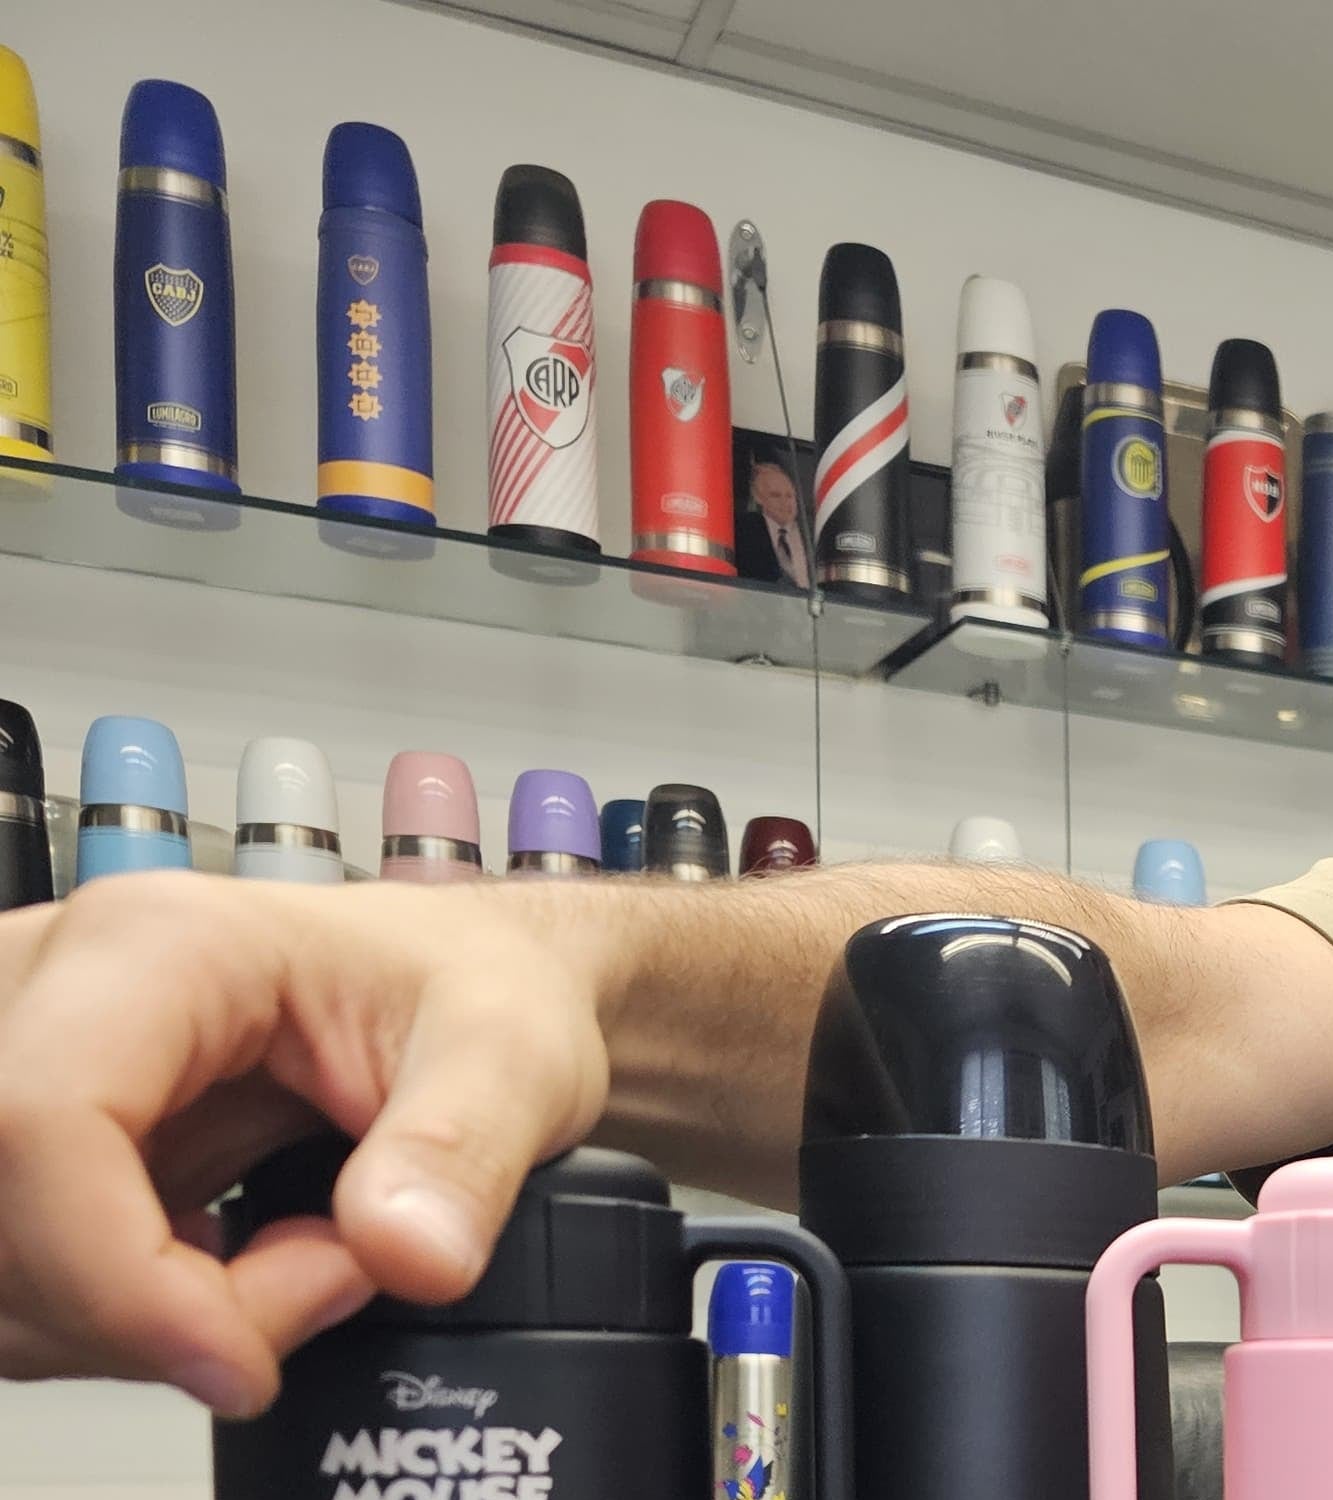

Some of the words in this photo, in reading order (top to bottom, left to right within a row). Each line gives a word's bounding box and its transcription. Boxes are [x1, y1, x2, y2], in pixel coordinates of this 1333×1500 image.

[152, 282, 196, 303] CABJ
[525, 356, 580, 408] CARP
[379, 1369, 499, 1420] Disney
[319, 1425, 563, 1477] MICKEY
